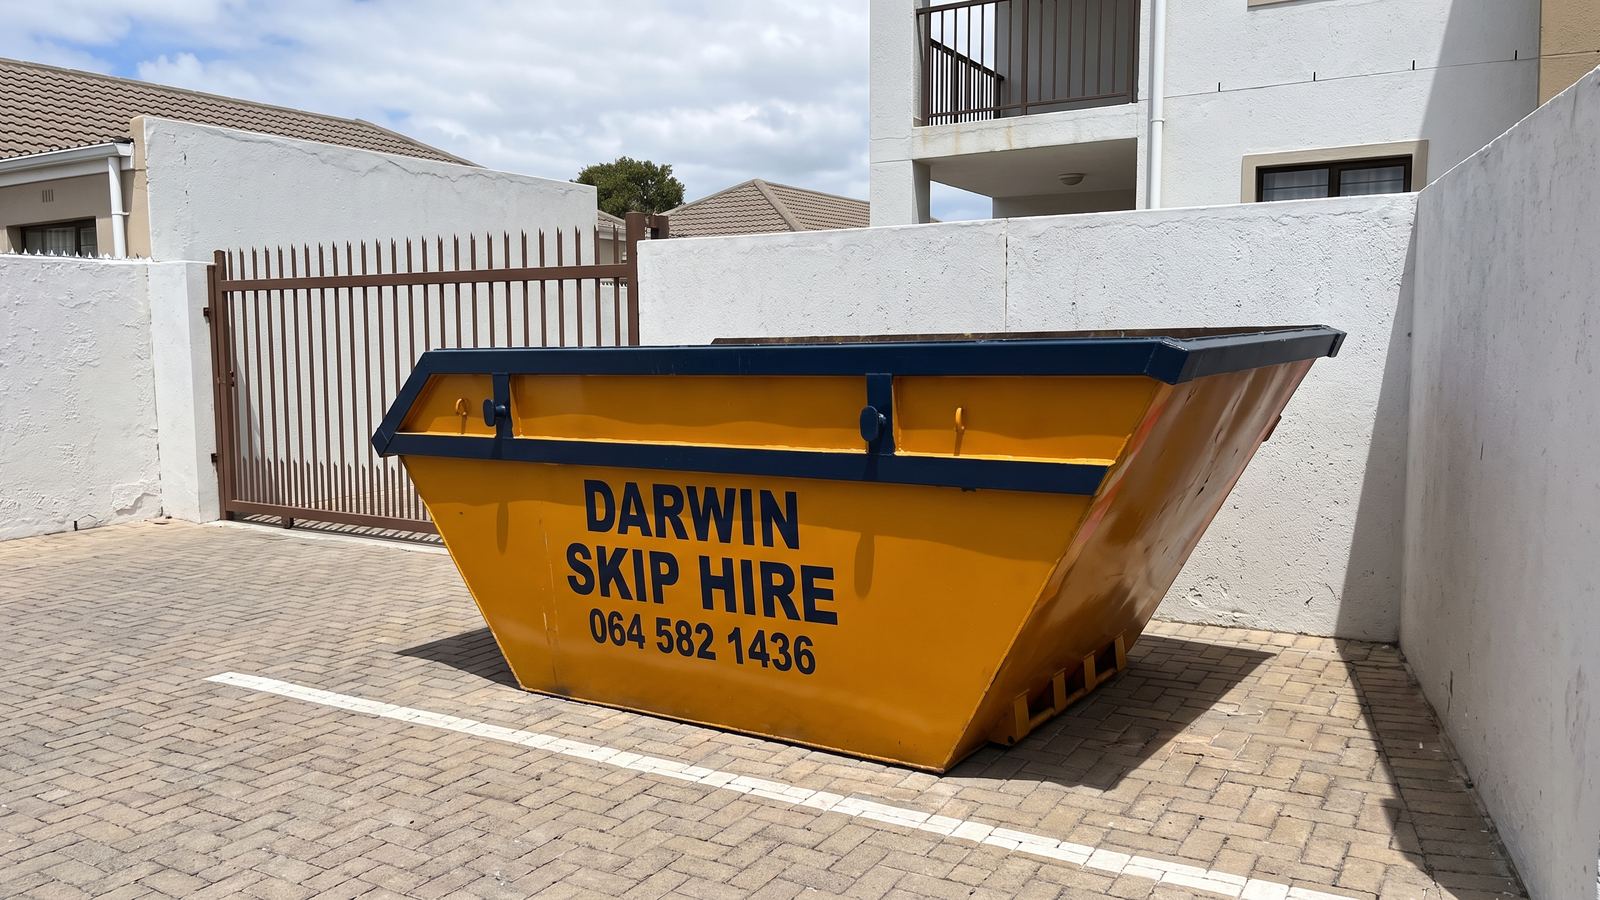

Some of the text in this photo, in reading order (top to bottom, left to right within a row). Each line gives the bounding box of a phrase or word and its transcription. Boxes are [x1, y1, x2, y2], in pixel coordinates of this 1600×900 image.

[584, 479, 799, 549] DARWIN
[566, 542, 838, 625] SKIP HIRE
[589, 608, 816, 675] 064 582 1436
